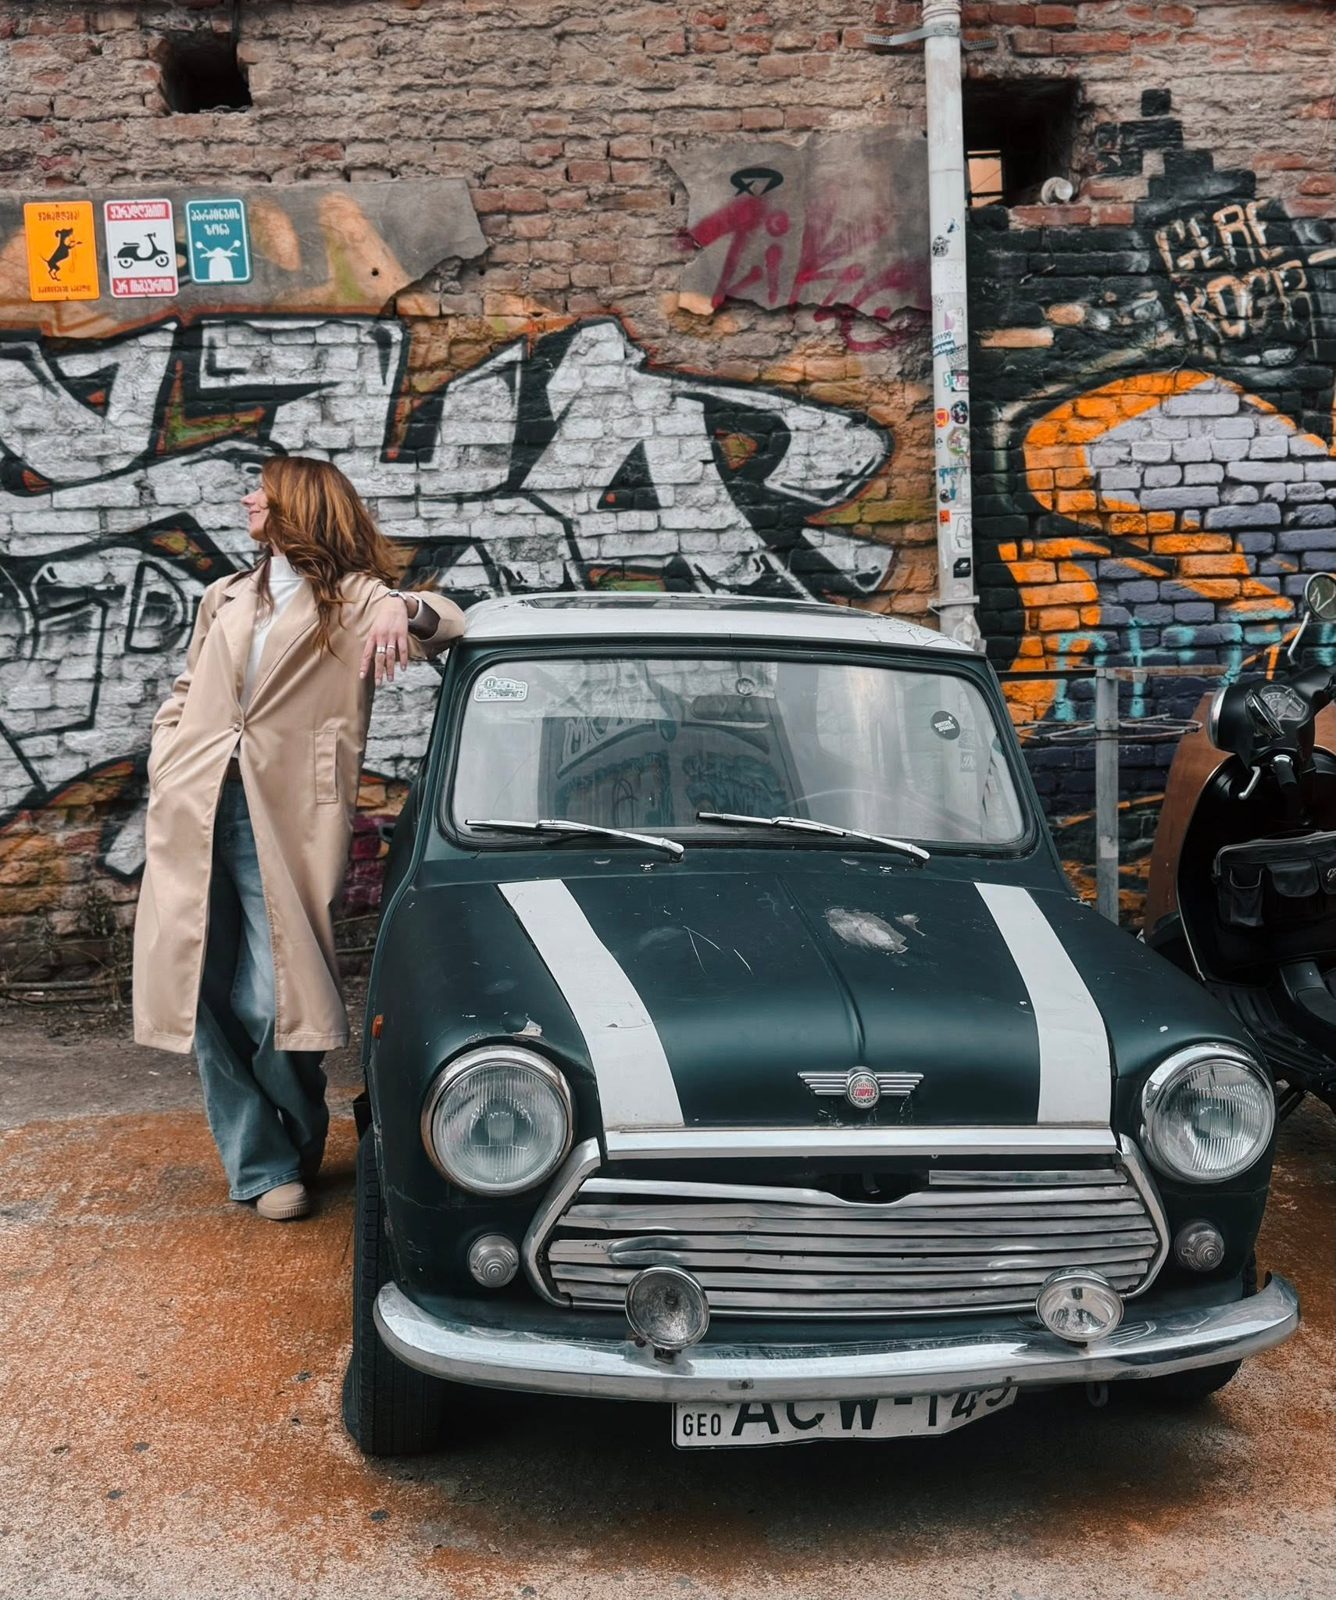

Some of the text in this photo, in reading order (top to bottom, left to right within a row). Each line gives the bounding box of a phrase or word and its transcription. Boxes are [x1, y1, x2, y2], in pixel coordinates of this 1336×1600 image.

[191, 208, 240, 221] პარკინგის
[204, 223, 230, 236] ზონა
[855, 1088, 874, 1097] COOPER
[682, 1413, 722, 1437] GEO
